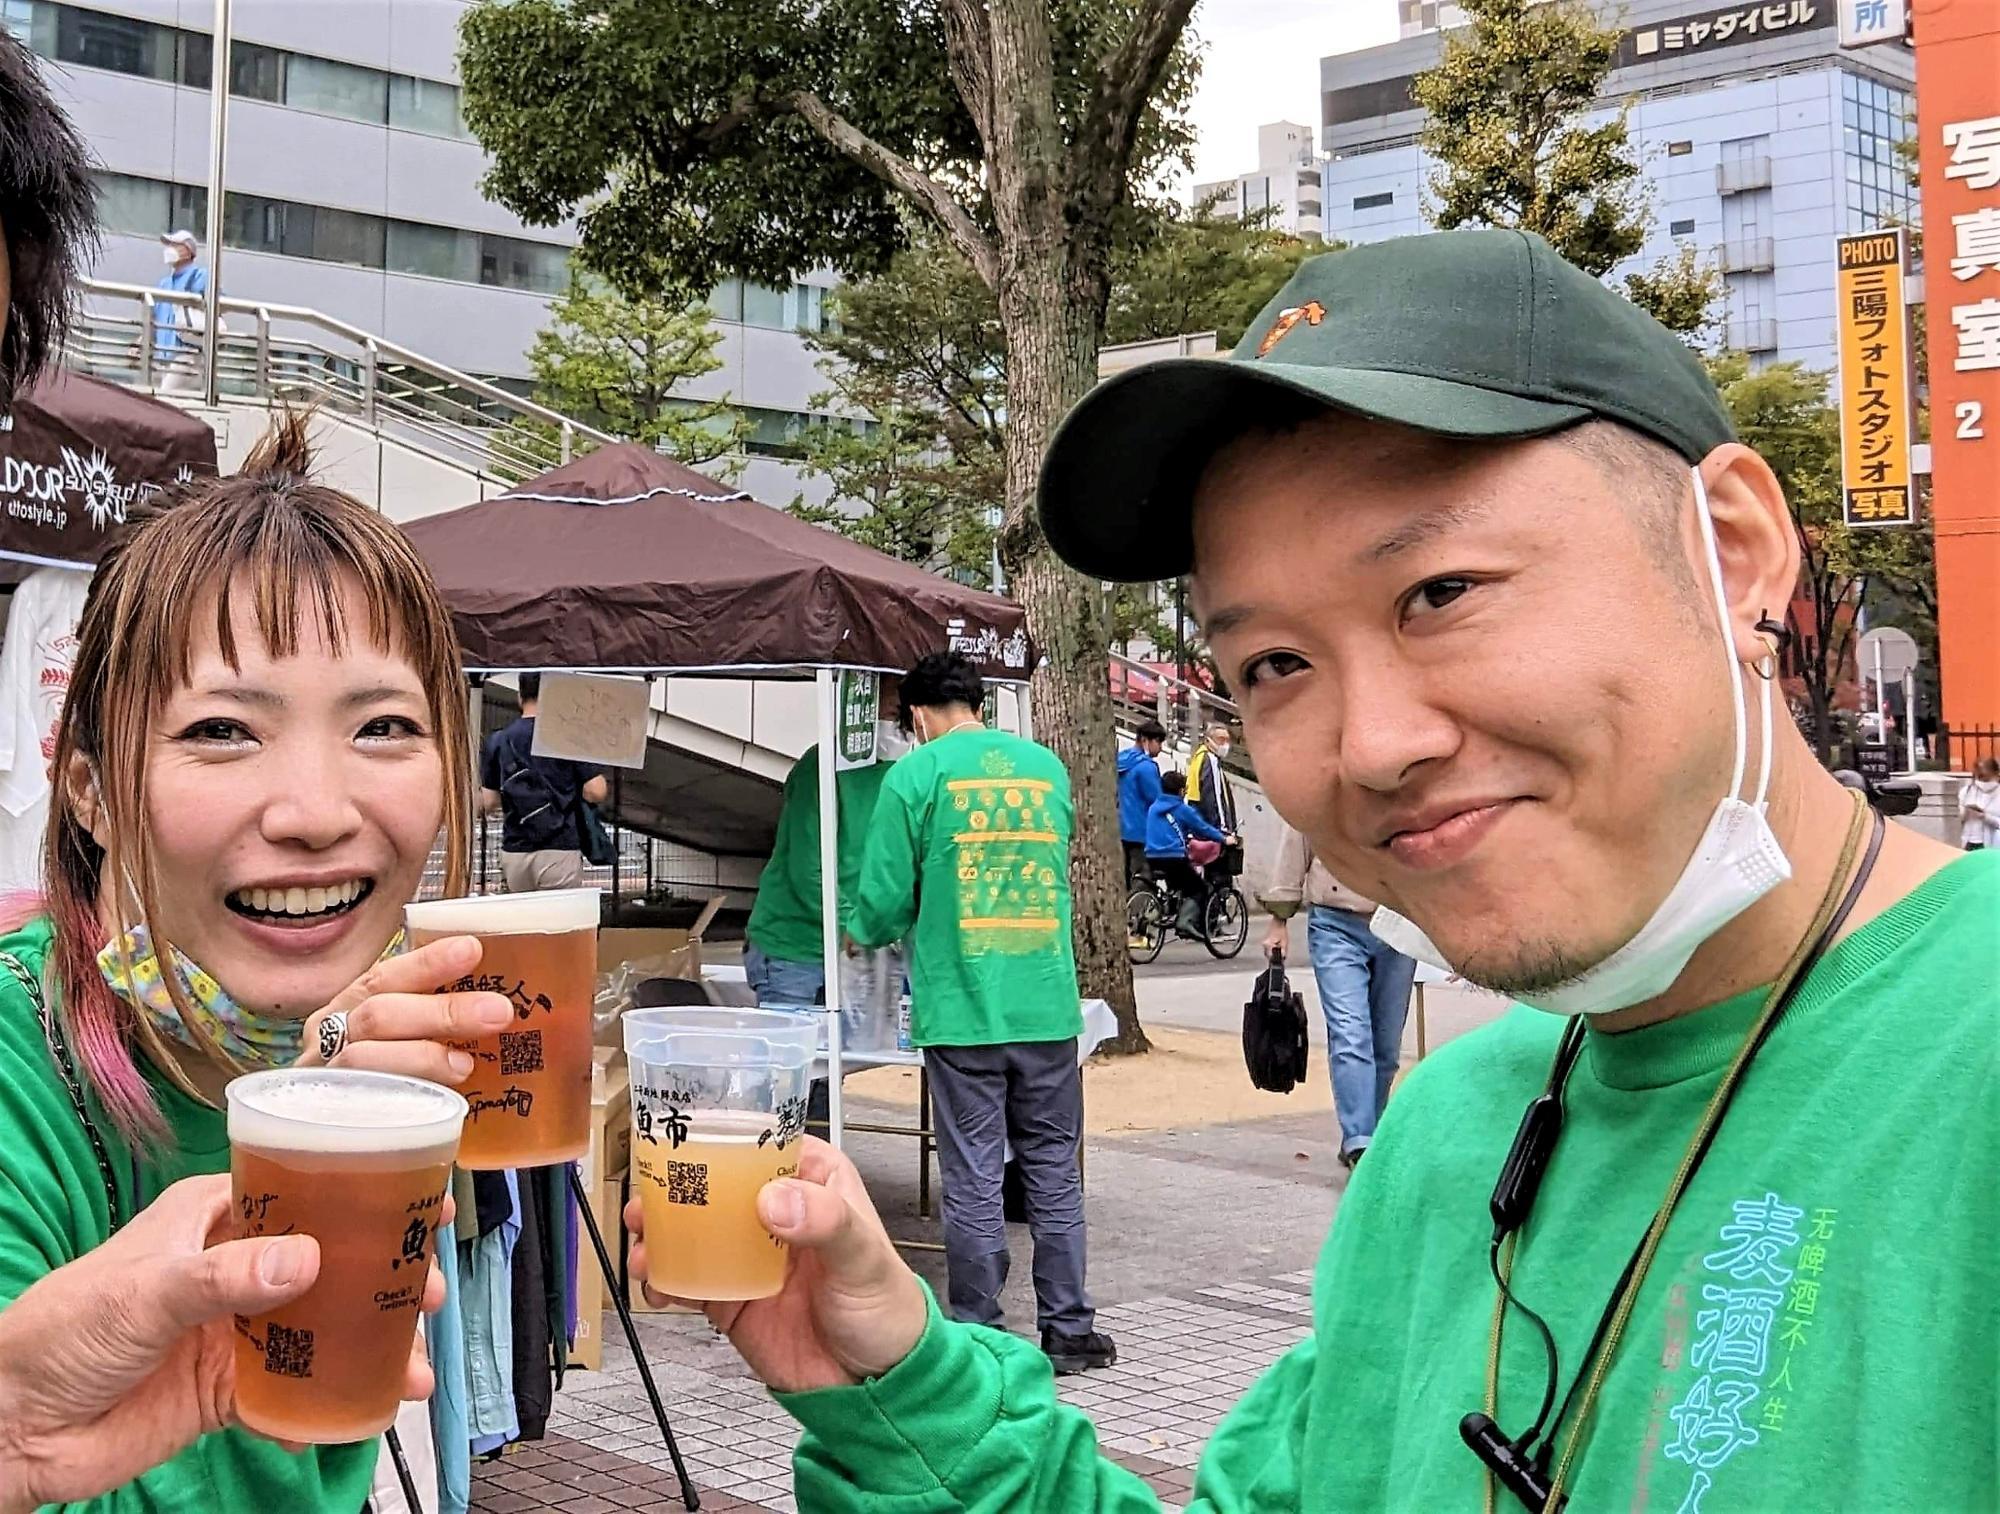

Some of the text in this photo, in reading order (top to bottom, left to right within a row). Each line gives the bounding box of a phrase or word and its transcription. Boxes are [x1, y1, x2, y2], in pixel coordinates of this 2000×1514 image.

[1664, 0, 1816, 49] ミヤダイビル
[1855, 0, 1887, 33] 所
[1840, 238, 1895, 266] PHOTO
[1943, 116, 2000, 372] 写真室
[1853, 271, 1894, 483] 三陽フォトスタジオ
[1954, 401, 1984, 439] 2
[1852, 488, 1906, 519] 写真
[1759, 1208, 1838, 1431] 无啤酒不人生
